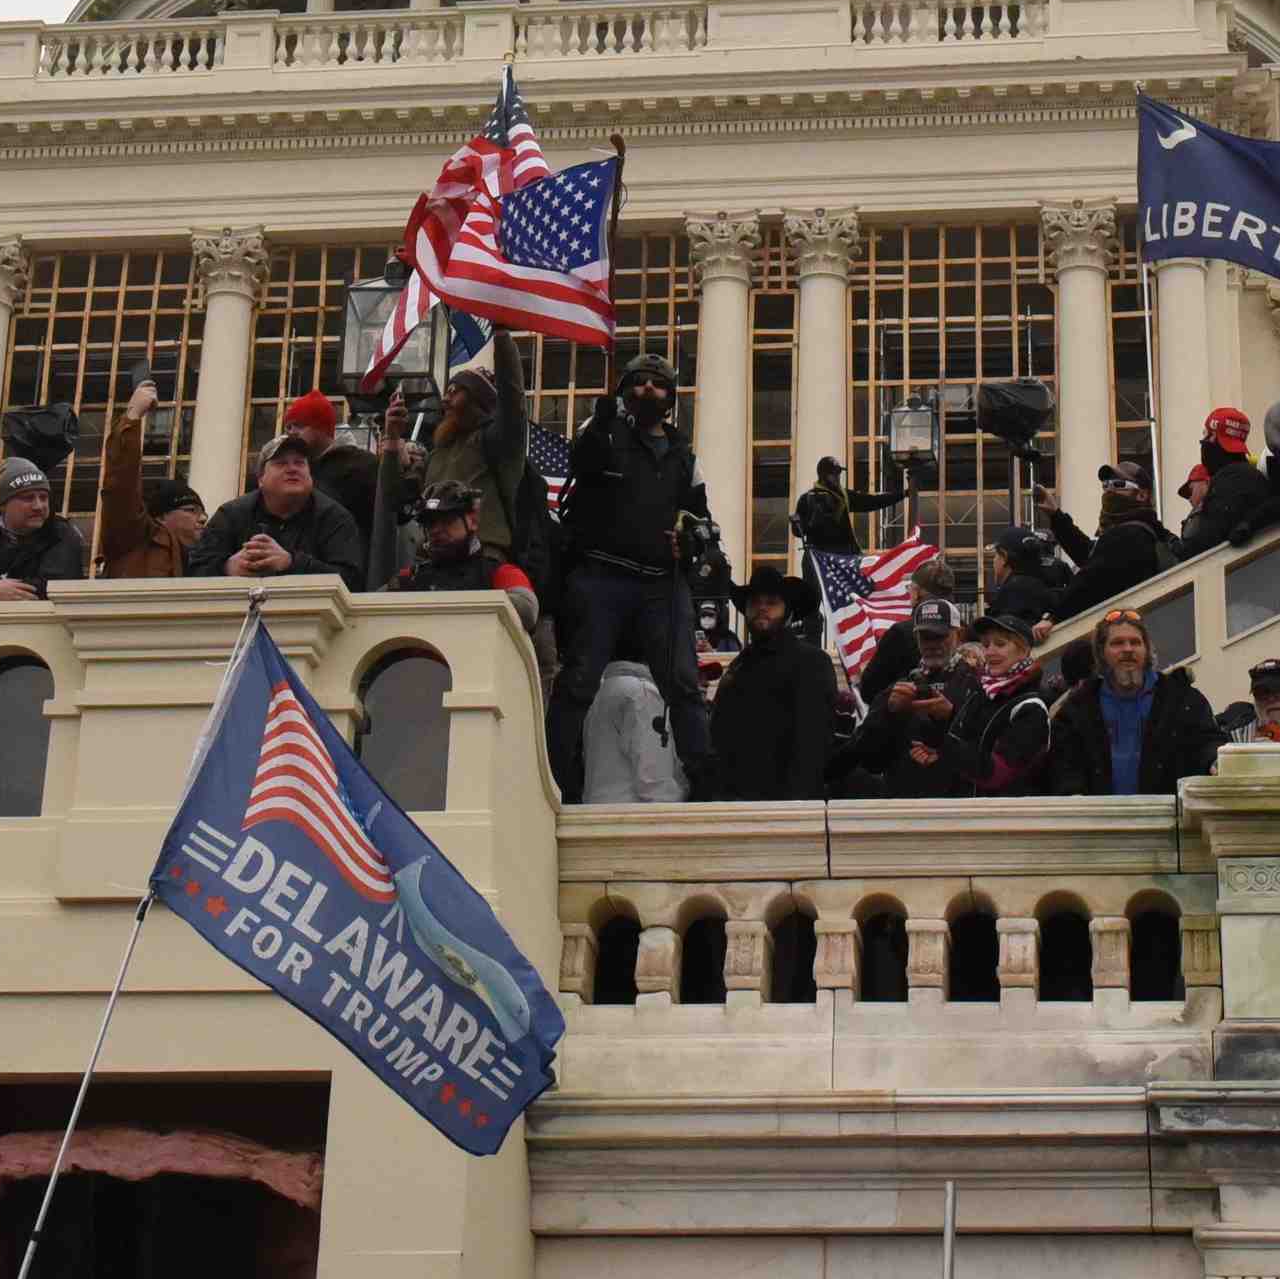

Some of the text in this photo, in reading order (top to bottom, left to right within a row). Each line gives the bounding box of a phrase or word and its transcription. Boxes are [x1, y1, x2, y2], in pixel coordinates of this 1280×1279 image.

[222, 835, 507, 1082] DELAWARE
[224, 908, 444, 1086] FOR TRUMP
